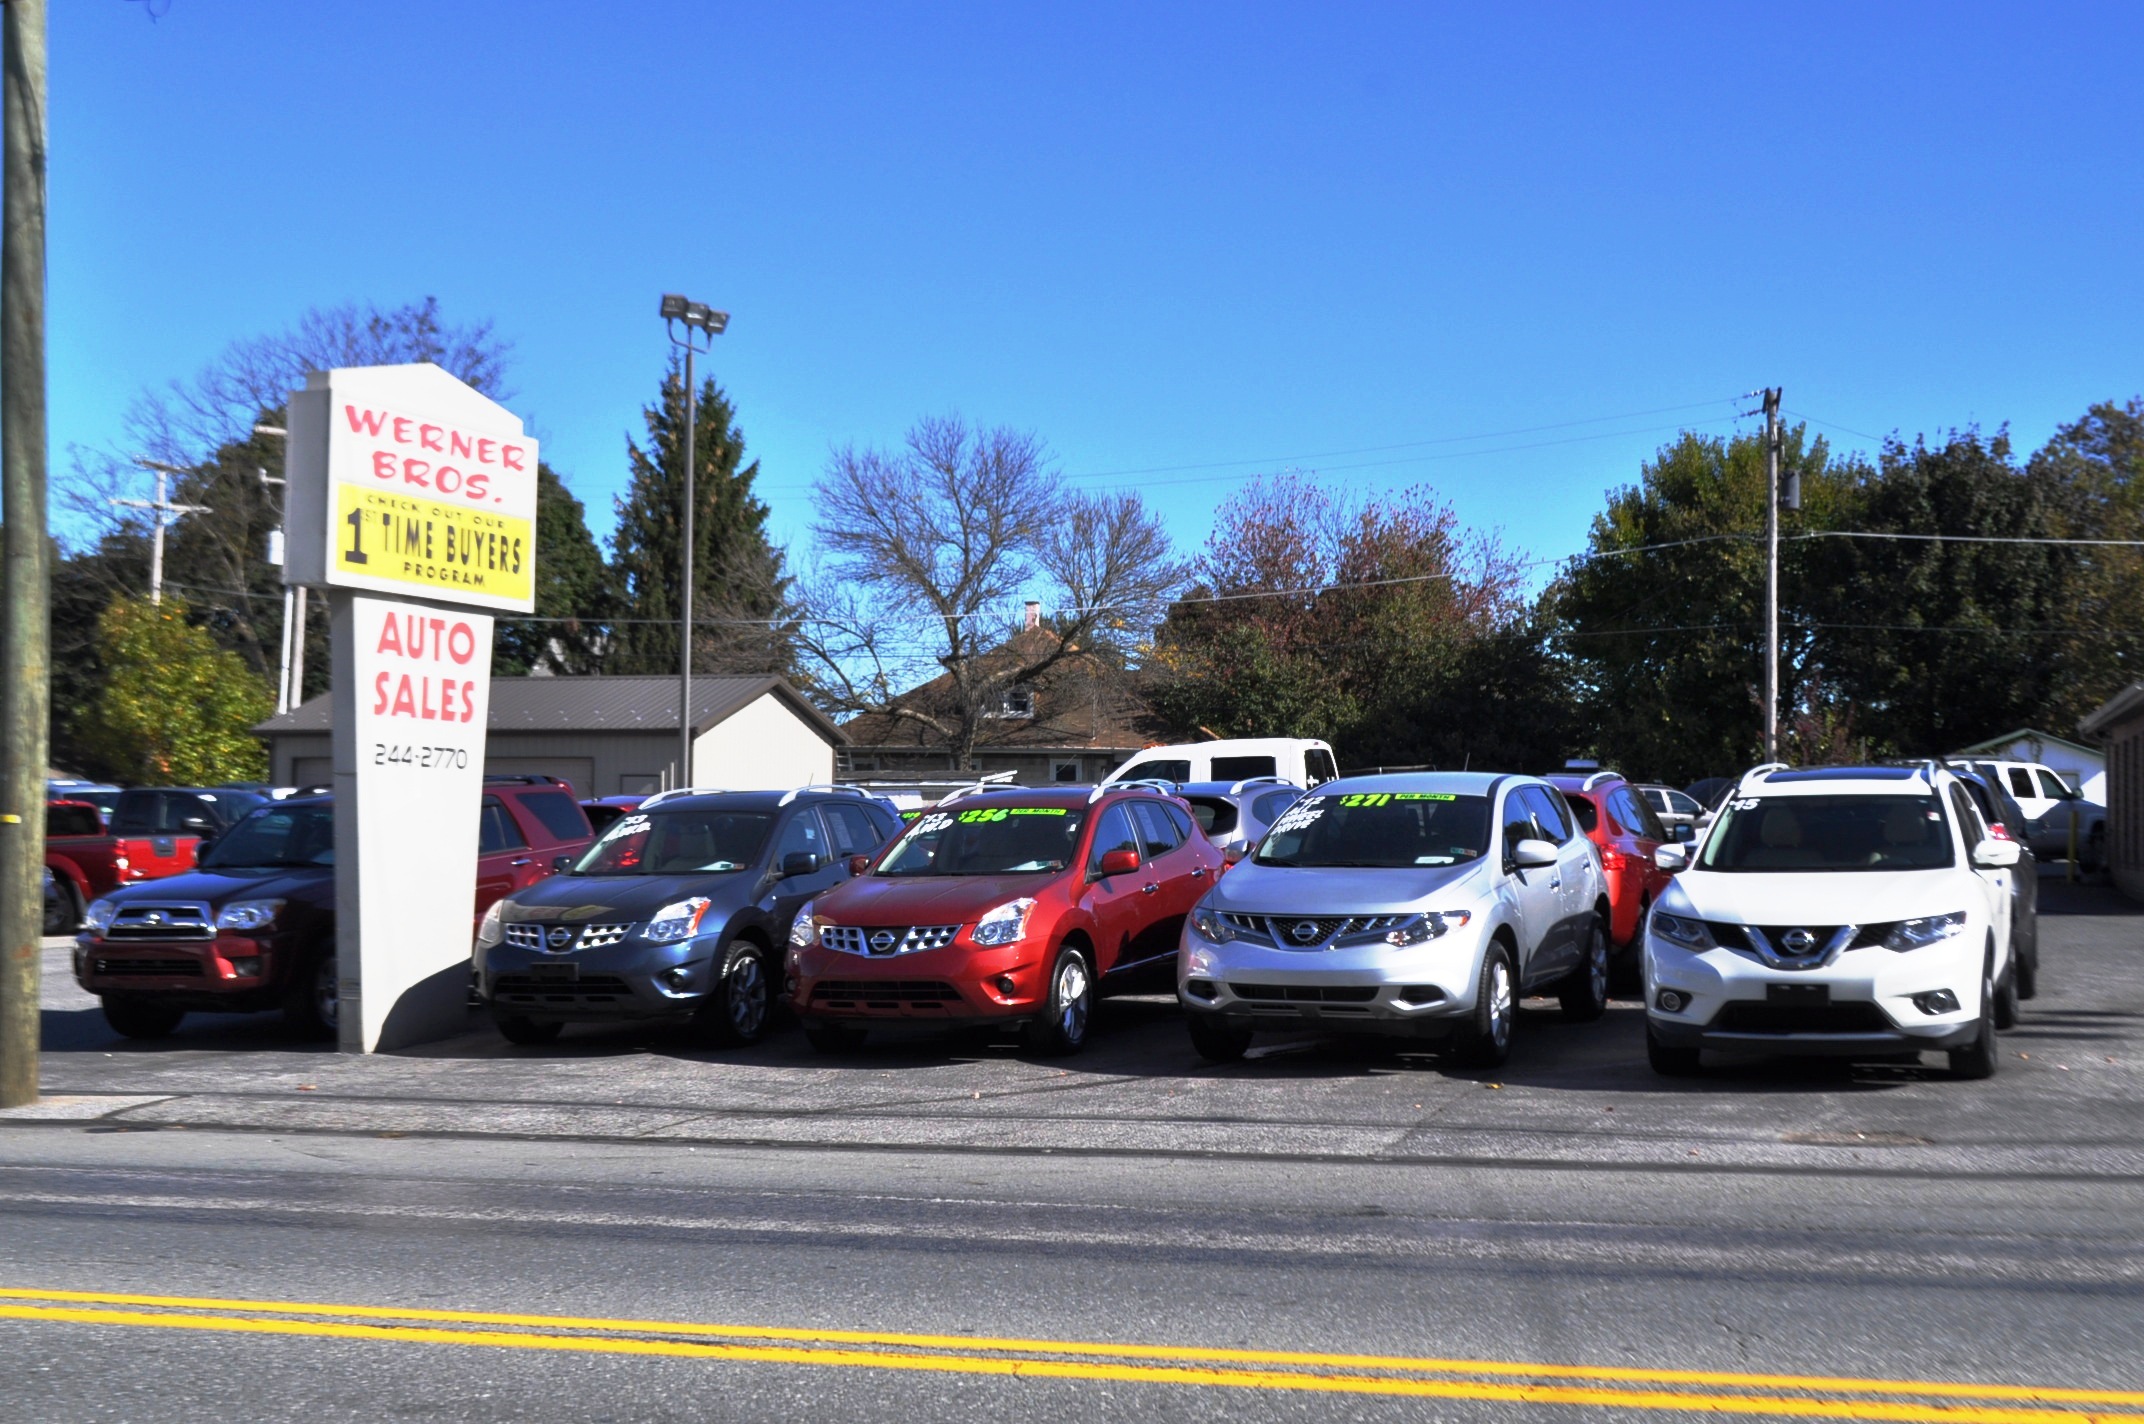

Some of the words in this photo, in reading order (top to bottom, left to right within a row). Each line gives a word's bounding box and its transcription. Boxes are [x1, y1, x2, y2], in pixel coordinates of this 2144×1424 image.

[345, 404, 525, 472] WERNER
[372, 450, 502, 503] BROS.
[382, 512, 433, 559] TIME
[446, 524, 521, 575] BUYERS
[432, 507, 461, 520] OUT
[473, 516, 504, 528] OUR
[403, 561, 485, 587] PROGRAM
[377, 612, 475, 665] AUTO
[373, 671, 475, 723] SALES
[375, 743, 468, 770] 244-2770
[958, 808, 1009, 823] $256
